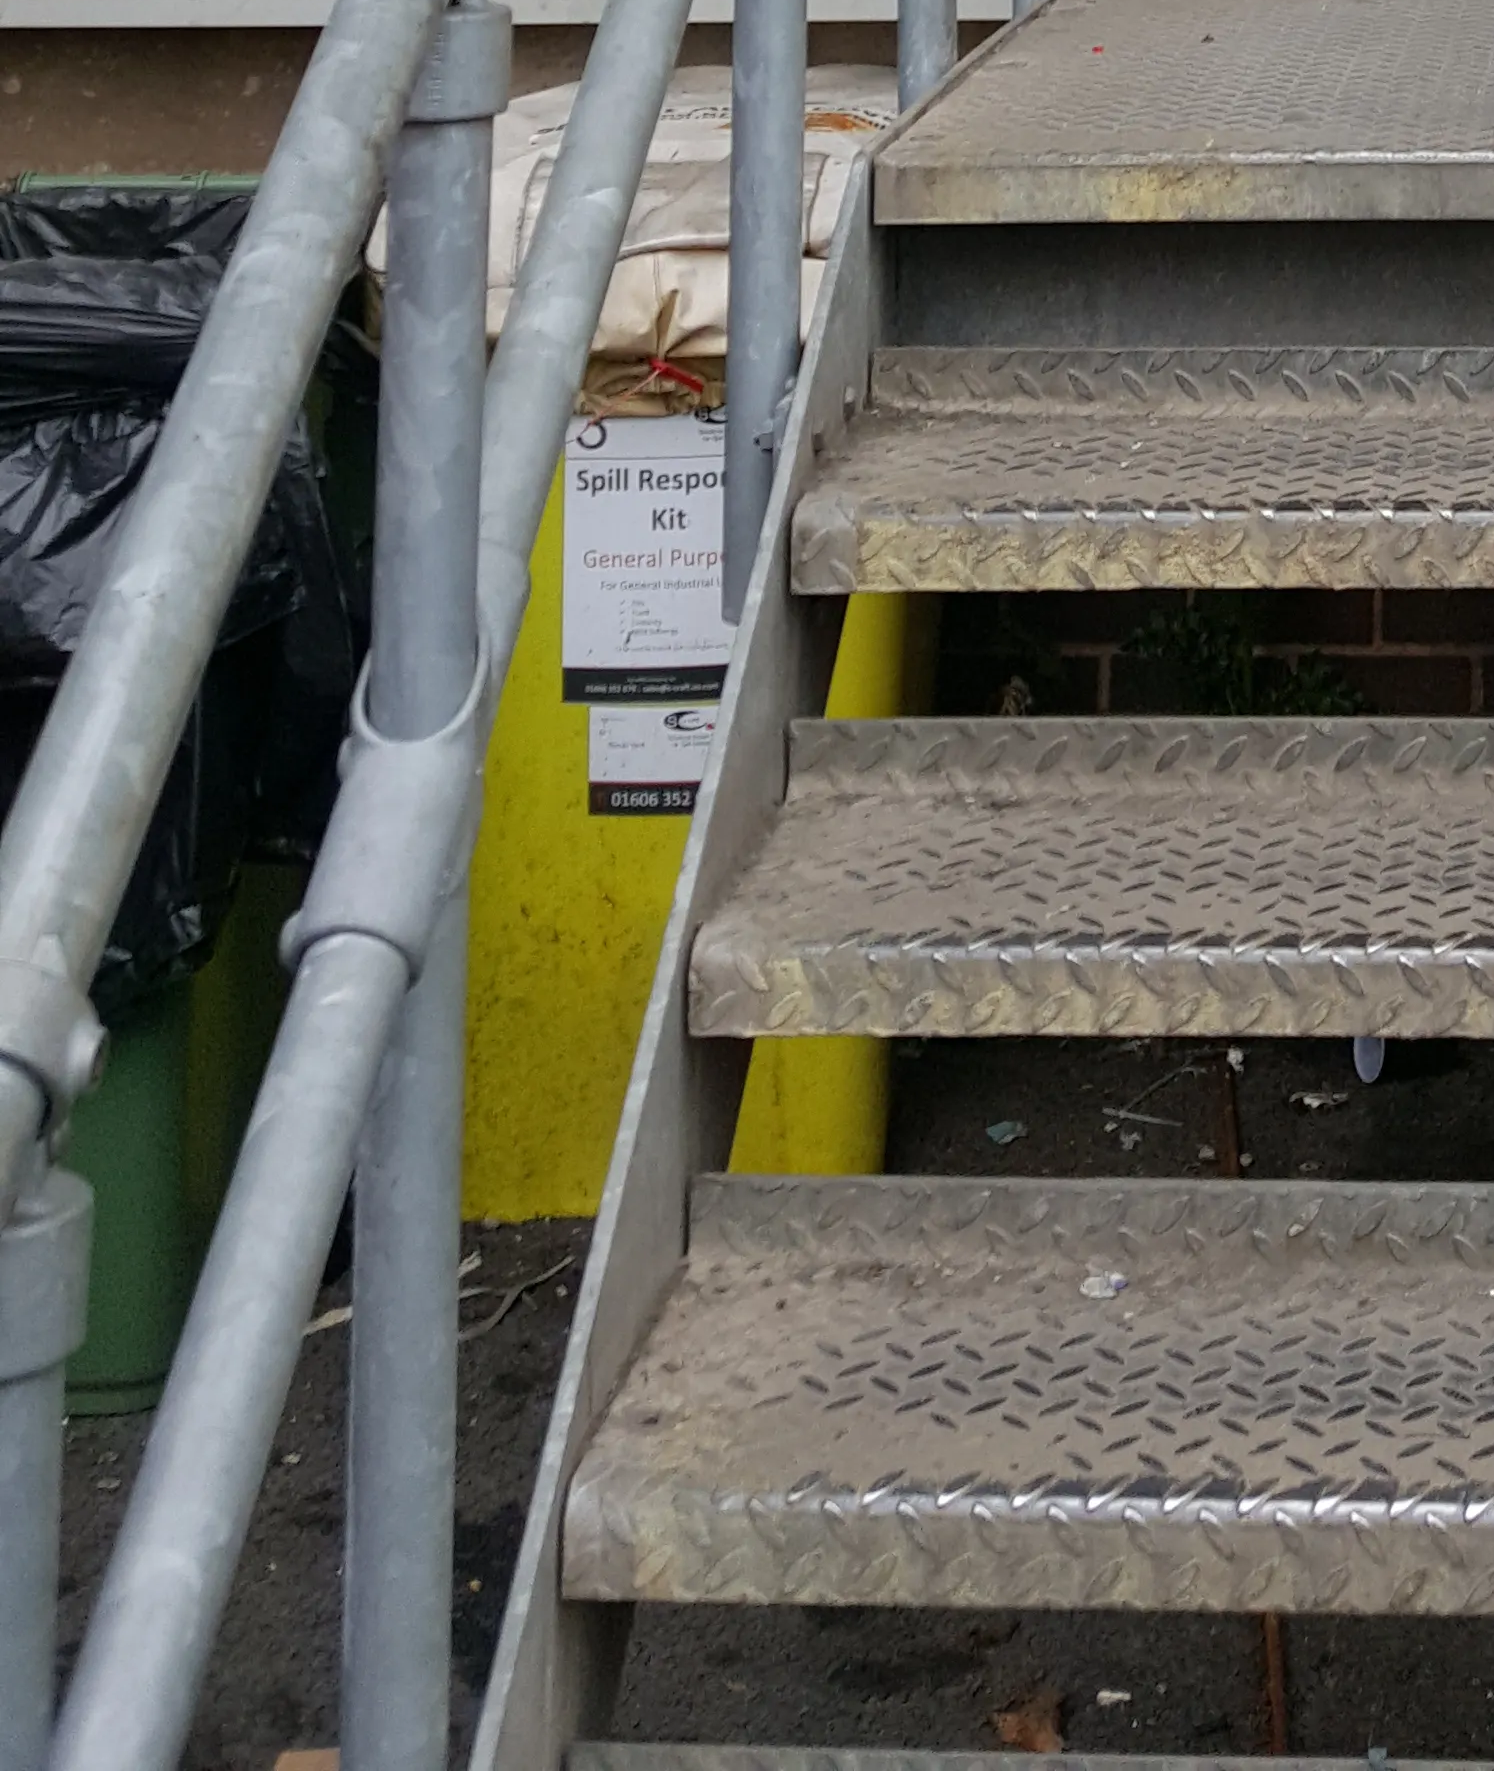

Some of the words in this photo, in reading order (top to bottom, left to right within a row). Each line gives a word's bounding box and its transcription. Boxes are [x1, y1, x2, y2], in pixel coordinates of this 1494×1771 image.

[576, 467, 629, 498] Spill
[638, 468, 726, 496] Respo
[651, 507, 687, 532] Kit
[583, 547, 662, 569] General
[600, 580, 617, 591] For
[610, 790, 659, 808] 01606
[662, 790, 691, 807] 352
